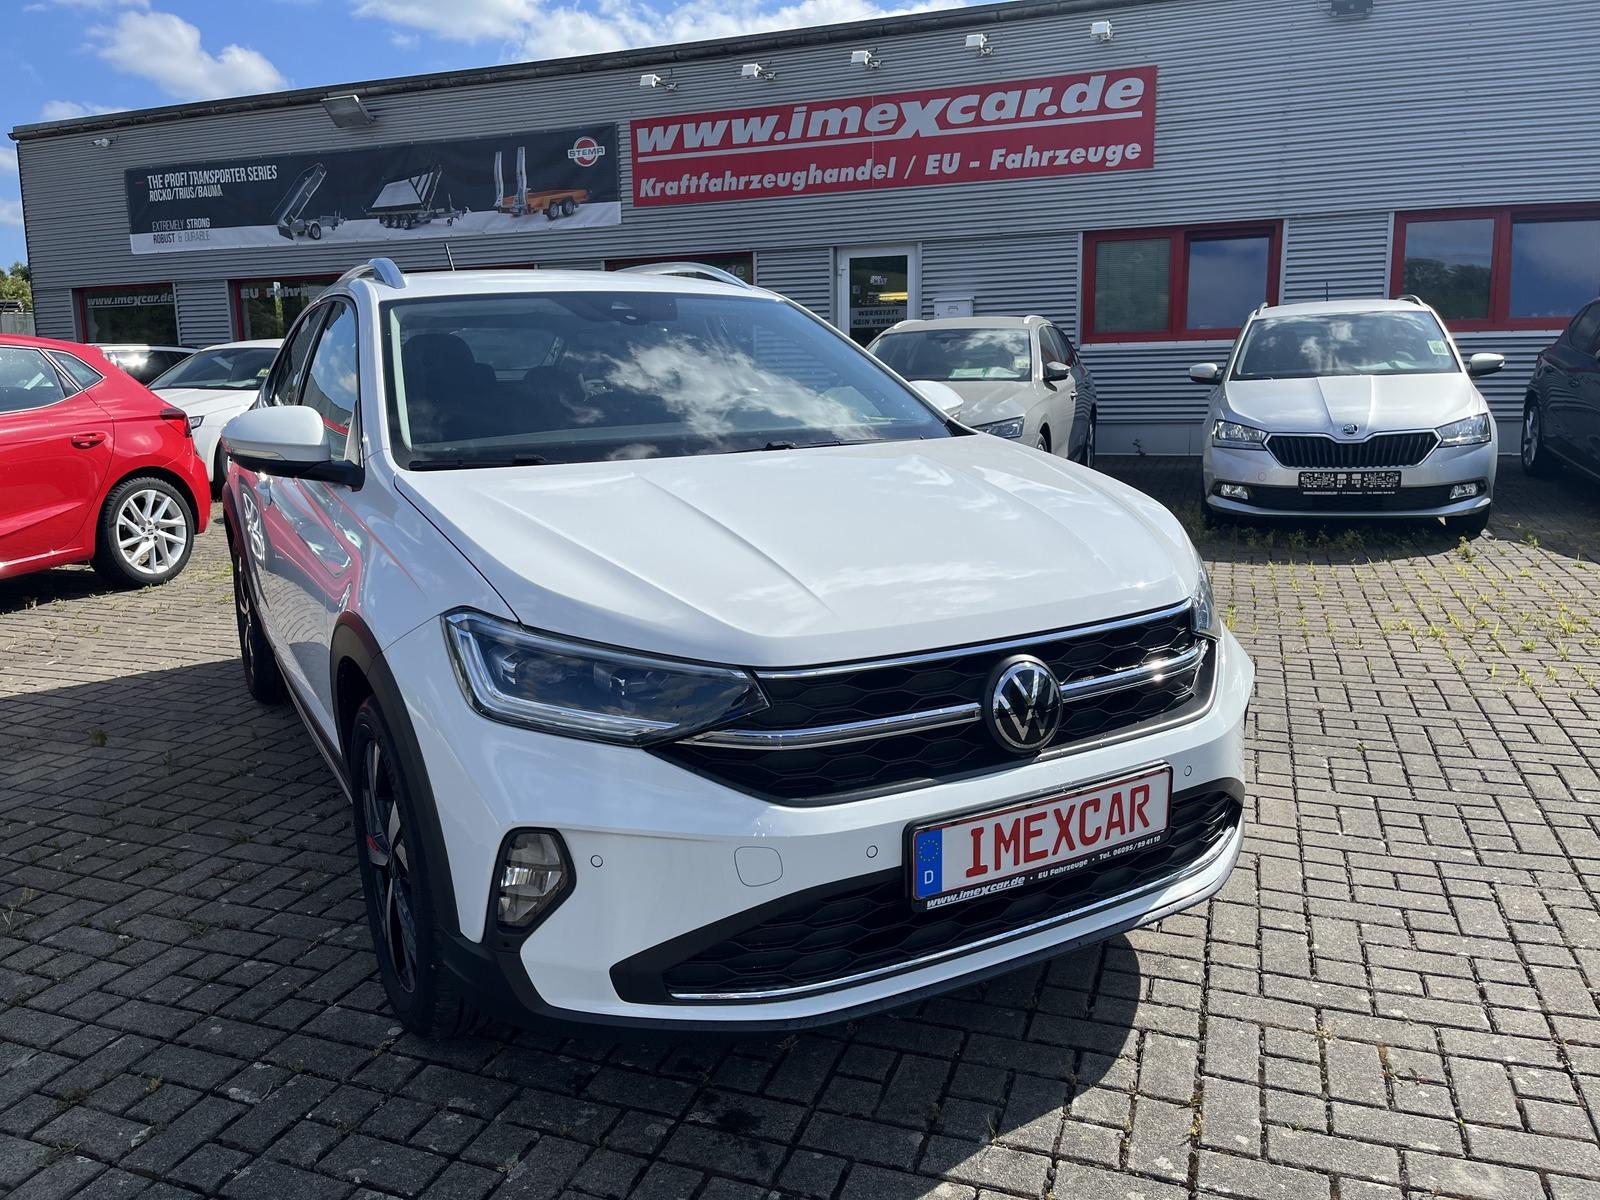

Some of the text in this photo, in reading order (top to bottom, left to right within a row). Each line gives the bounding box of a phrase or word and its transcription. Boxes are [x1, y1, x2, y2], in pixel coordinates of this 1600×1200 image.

[637, 75, 1144, 153] www.imexcar.de
[568, 148, 604, 157] STEMA
[147, 164, 278, 189] THE PROFI TRANSPORTER SERIES
[640, 156, 897, 198] Kraftfahrzeughandel
[904, 155, 916, 179] /
[925, 152, 961, 176] EU
[989, 142, 1142, 171] Fahrzeuge
[149, 184, 224, 202] ROCKO/TRIUS/BAUMA
[152, 218, 211, 232] EXTREMELY STRONG
[152, 232, 175, 244] ROBUST
[184, 231, 210, 241] DURABLE
[87, 292, 174, 306] www.imexcar.de
[240, 287, 259, 299] EU
[965, 783, 1150, 878] IMEXCAR
[924, 870, 934, 885] D
[926, 875, 1026, 909] www.imexcar.de
[1037, 870, 1049, 880] EU
[1049, 857, 1088, 877] Fahrzeuge
[1099, 851, 1112, 861] Tel.
